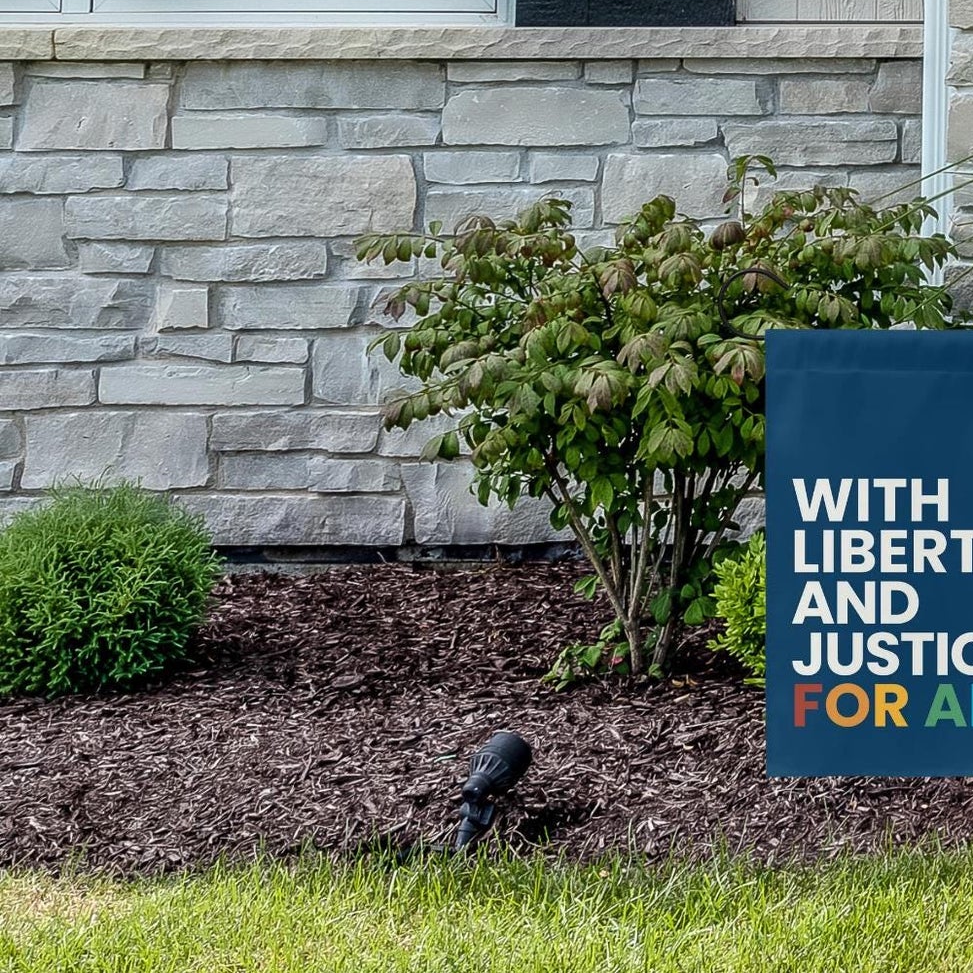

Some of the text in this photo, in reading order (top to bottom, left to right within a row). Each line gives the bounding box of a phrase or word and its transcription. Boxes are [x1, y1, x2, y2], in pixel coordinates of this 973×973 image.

[792, 478, 949, 522] WITH
[792, 581, 919, 624] AND
[793, 683, 909, 728] FOR
